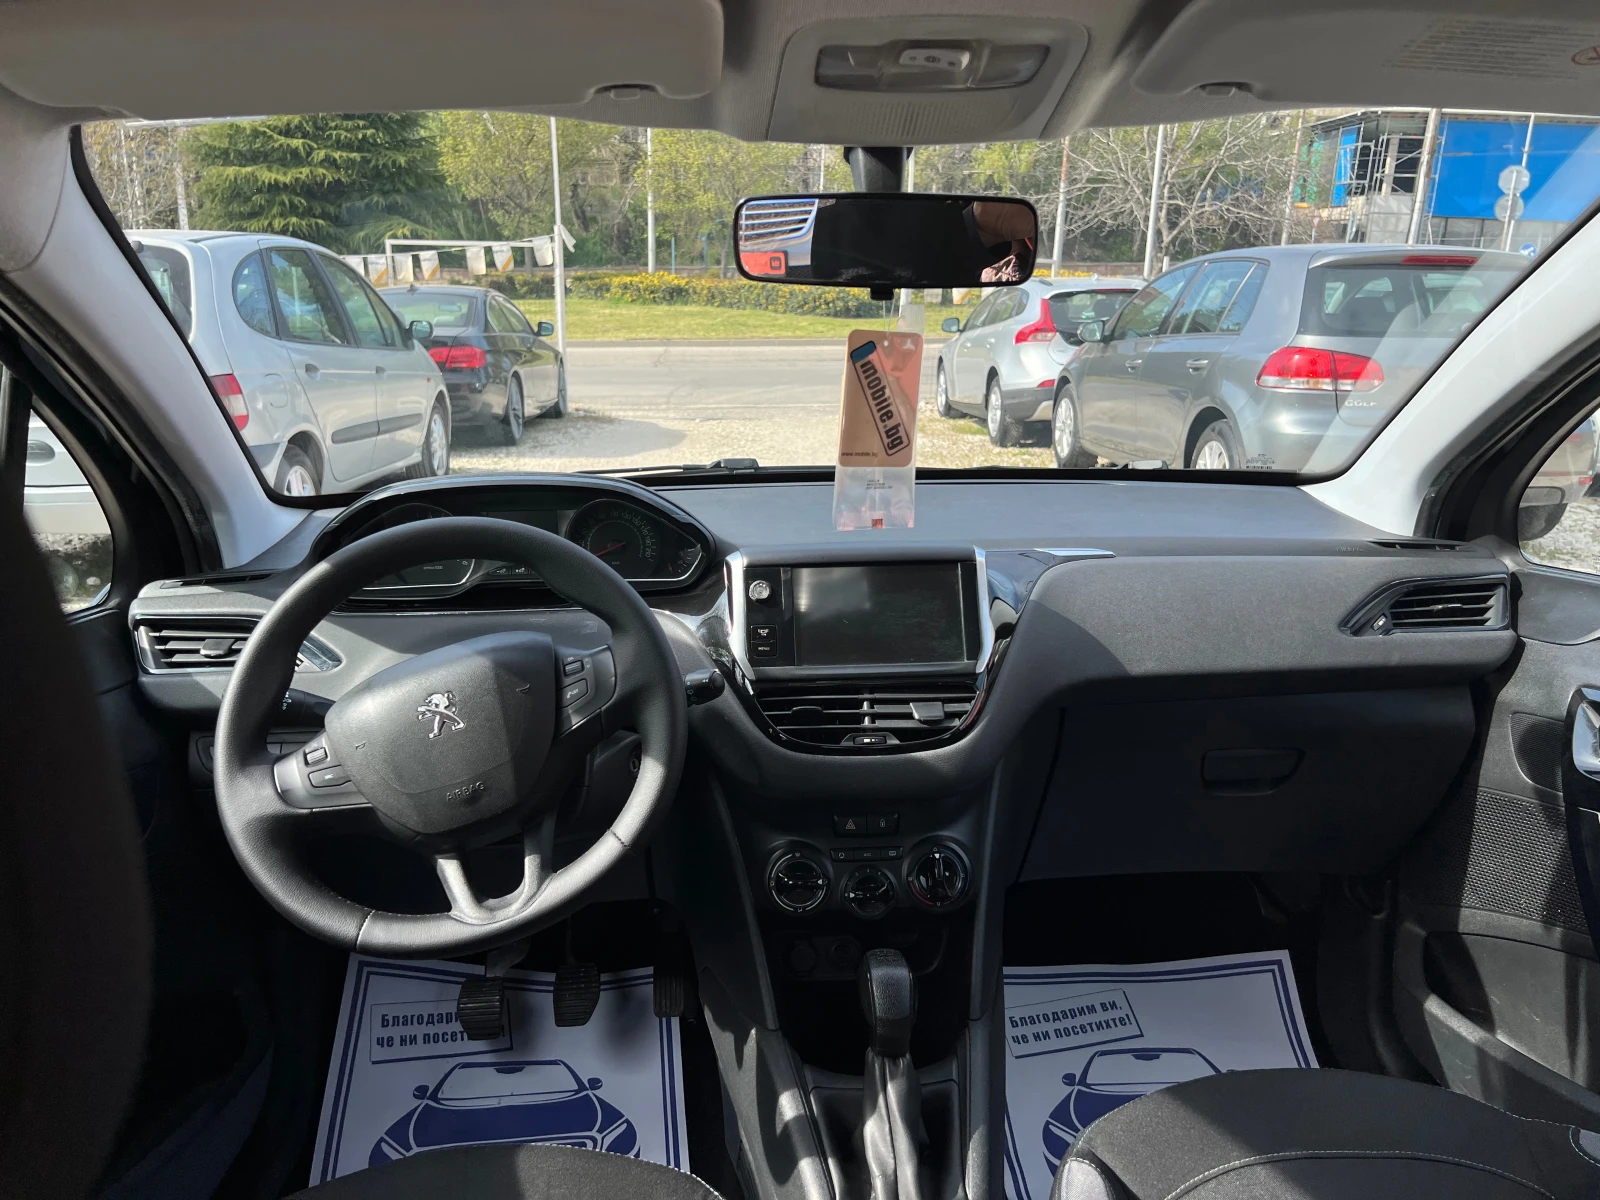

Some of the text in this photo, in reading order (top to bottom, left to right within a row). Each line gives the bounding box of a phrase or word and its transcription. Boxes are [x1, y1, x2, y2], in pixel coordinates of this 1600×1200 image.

[860, 360, 904, 452] mobile.bg
[1344, 399, 1377, 407] GOLF
[446, 781, 485, 800] AIRBAG
[381, 1011, 459, 1028] Благодар
[1008, 1000, 1123, 1028] Благодарим ви,
[1011, 1013, 1133, 1045] че ни посетихте!
[376, 1035, 394, 1048] че
[400, 1032, 418, 1047] ни
